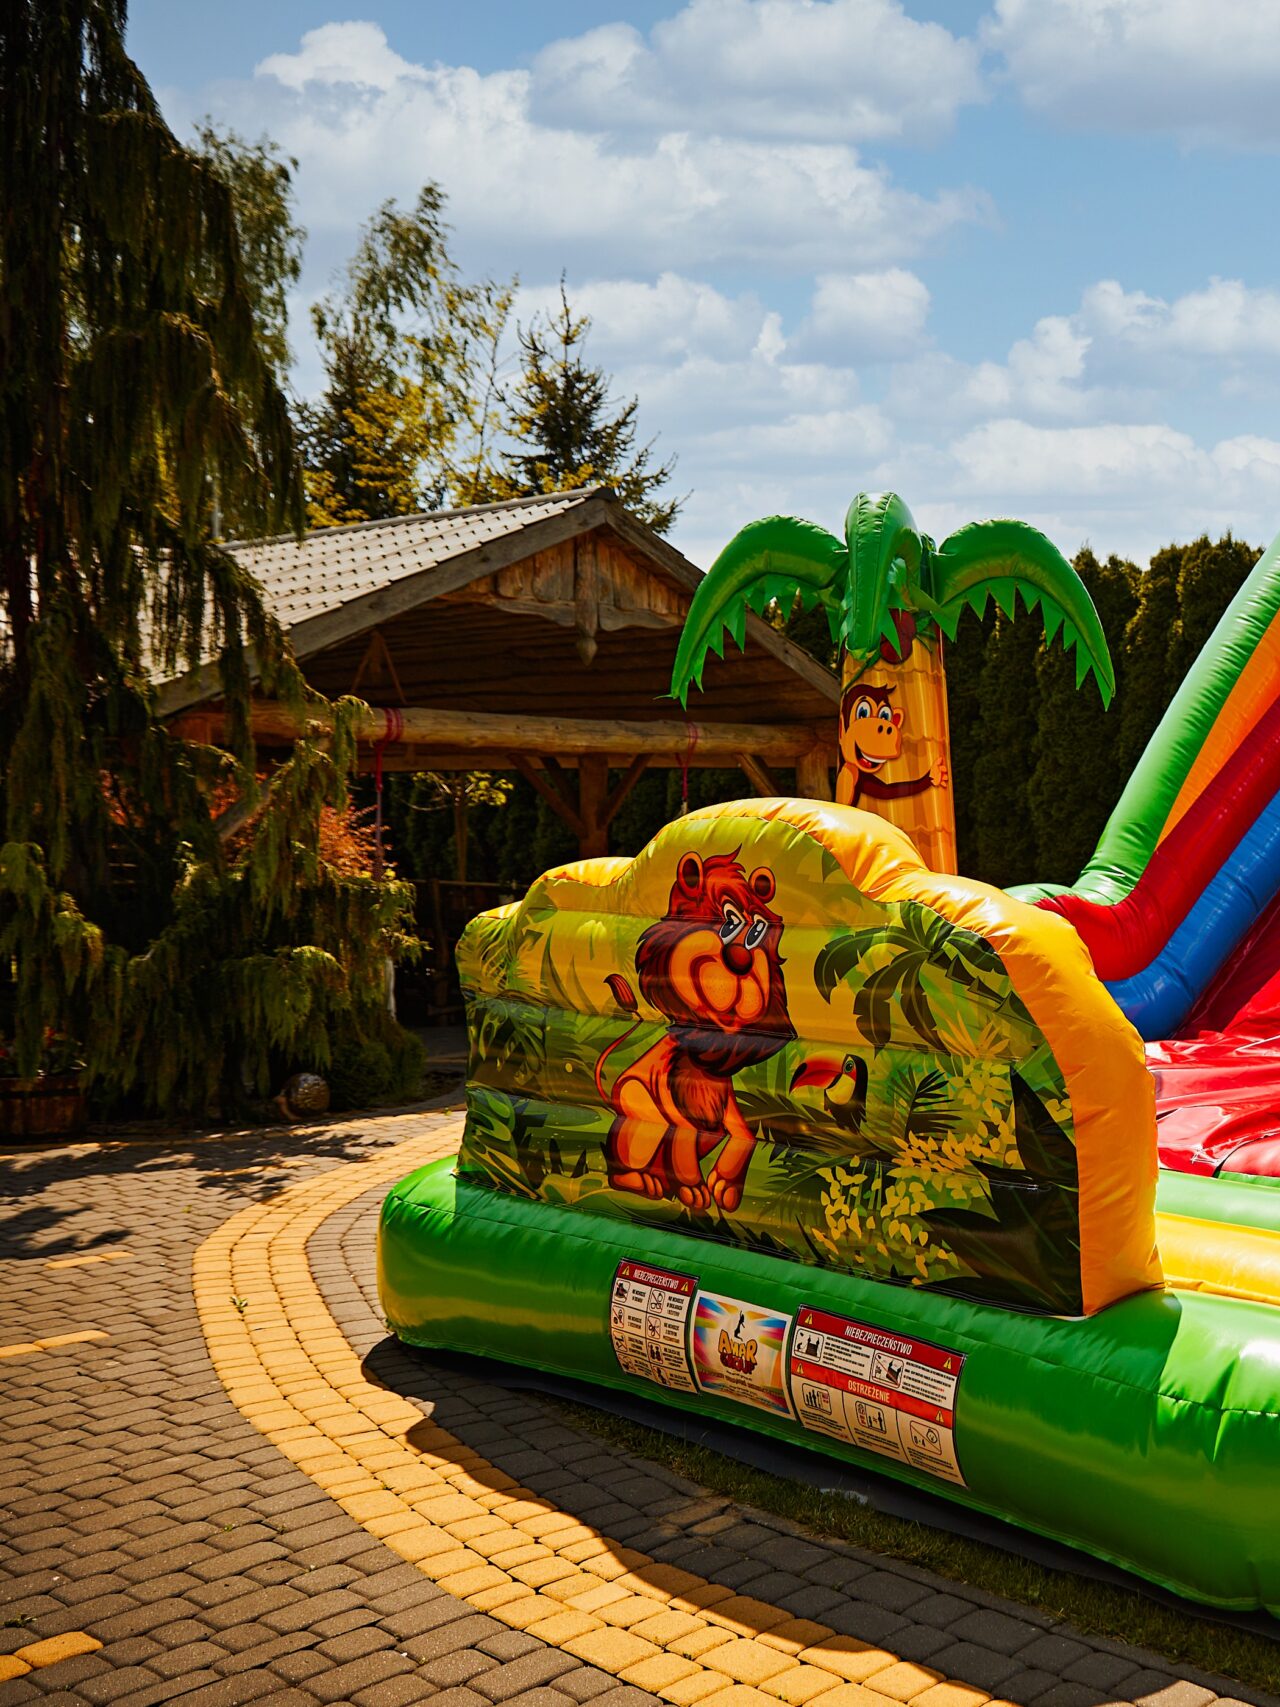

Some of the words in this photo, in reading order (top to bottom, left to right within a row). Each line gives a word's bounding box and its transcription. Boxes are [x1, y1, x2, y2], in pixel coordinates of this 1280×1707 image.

[633, 1269, 679, 1289] NIEBEZPIECZEŃSTWO
[844, 1325, 913, 1356] NIEBEZPIECZEŃSTWO
[848, 1379, 891, 1404] OSTRZEŻENIE
